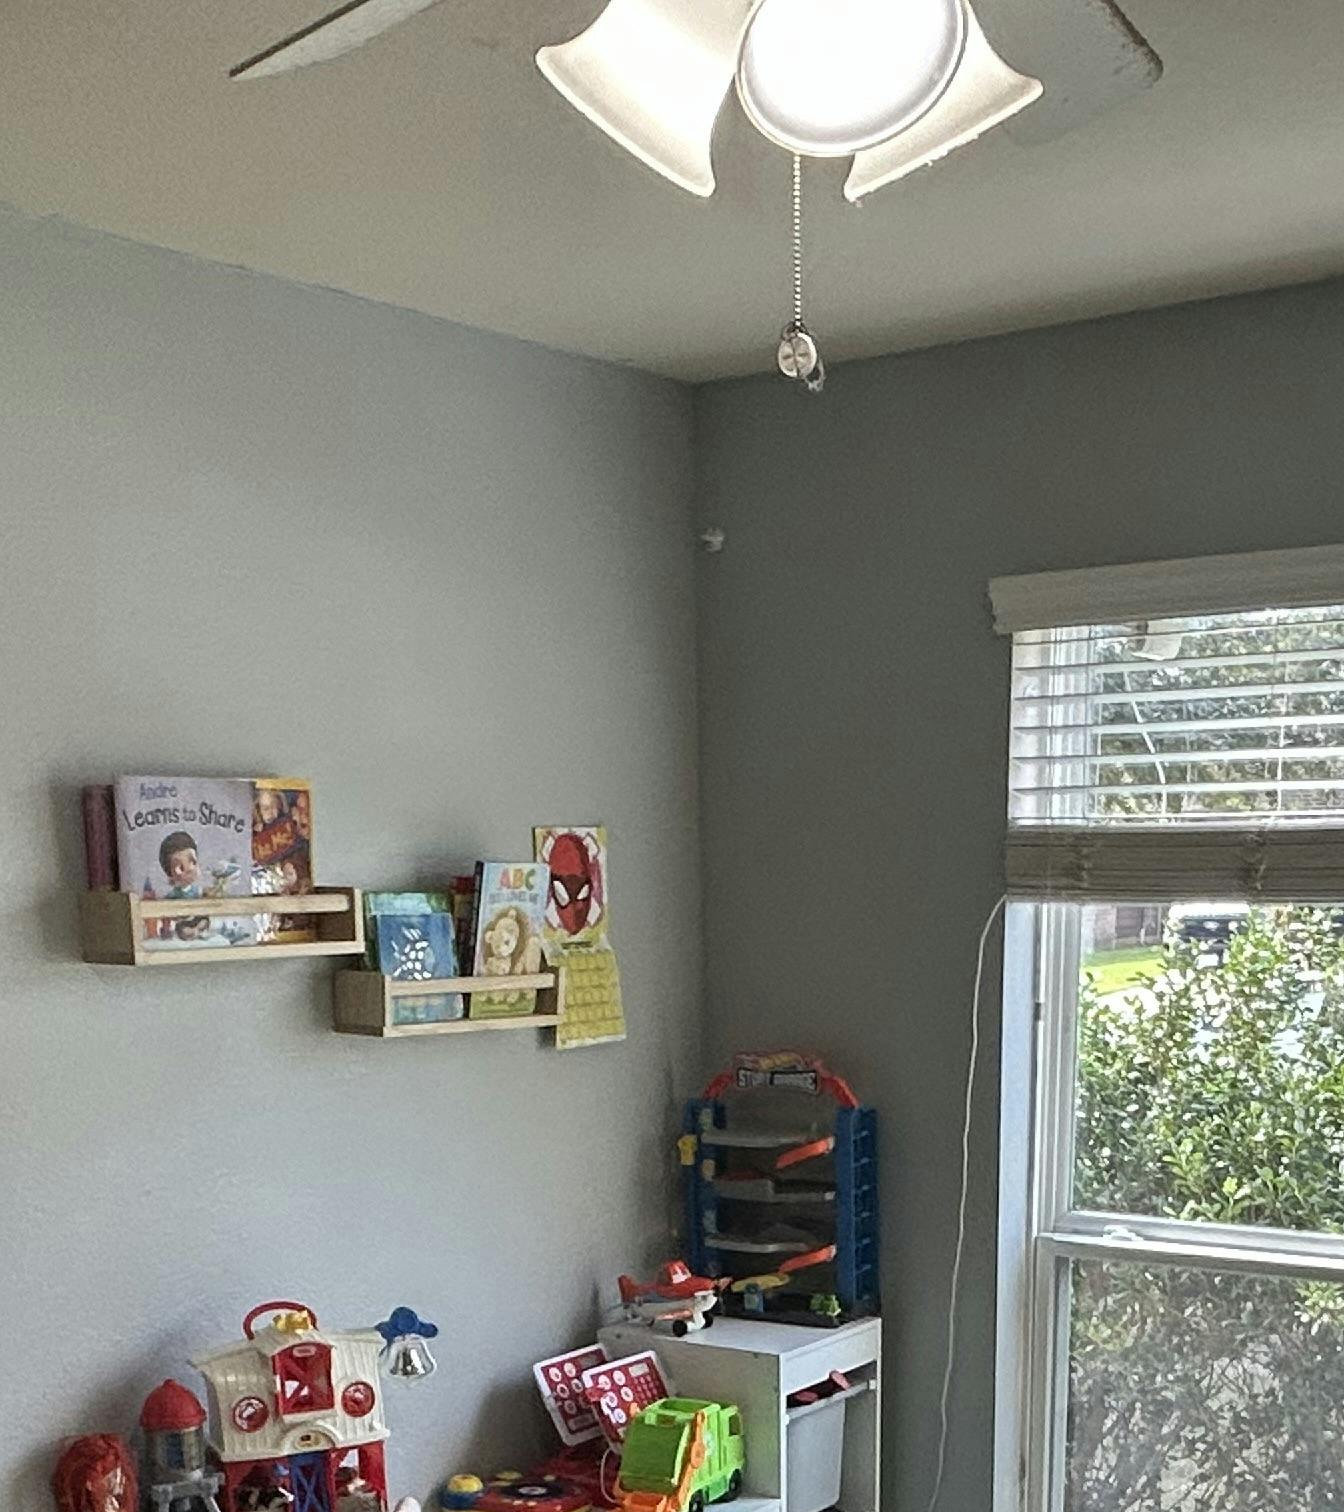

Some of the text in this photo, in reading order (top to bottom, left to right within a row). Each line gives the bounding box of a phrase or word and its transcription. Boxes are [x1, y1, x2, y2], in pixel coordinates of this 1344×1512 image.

[123, 801, 245, 833] Learns to Share
[499, 867, 536, 891] ABC
